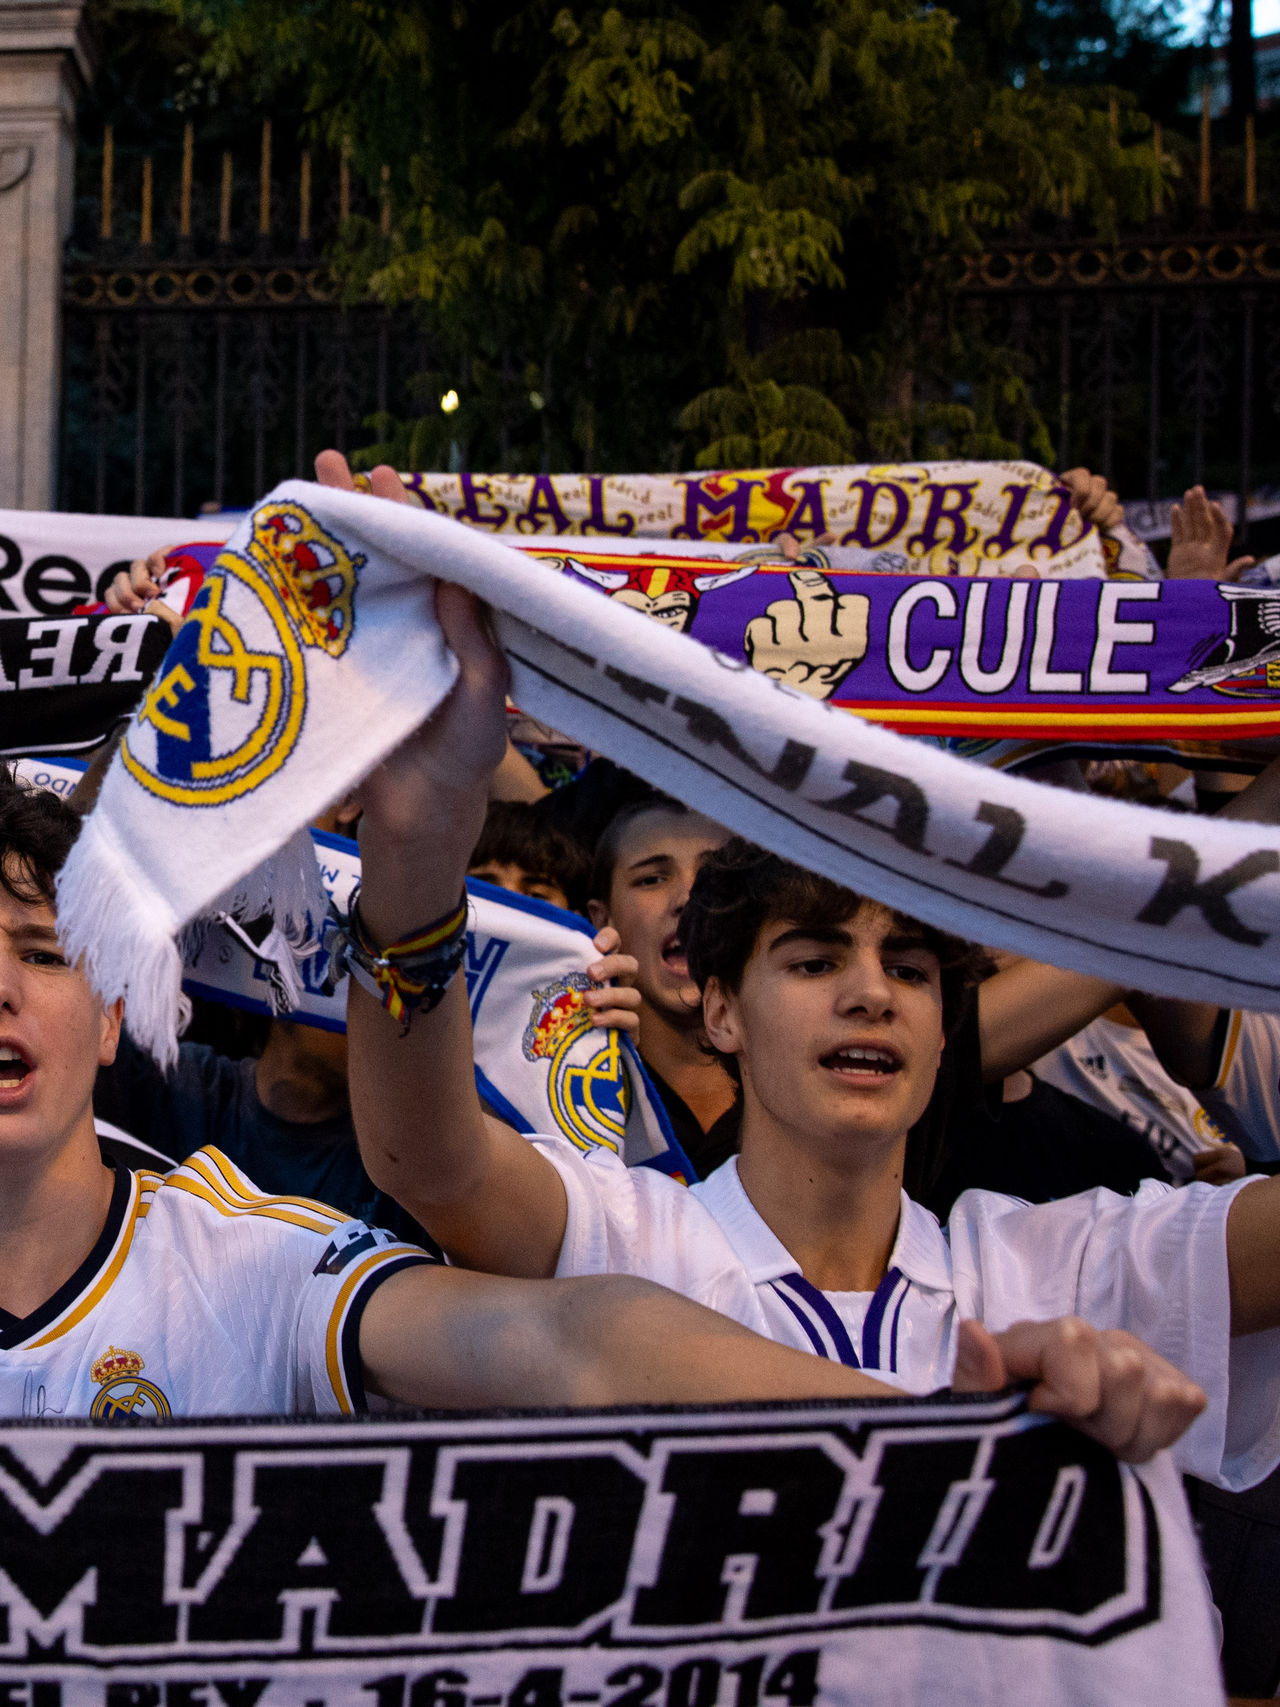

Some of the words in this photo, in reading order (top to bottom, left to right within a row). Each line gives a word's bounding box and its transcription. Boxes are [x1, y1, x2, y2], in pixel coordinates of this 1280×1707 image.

[671, 477, 1098, 561] MADRID
[887, 580, 1162, 695] CULE
[362, 1649, 823, 1707] 16-4-2014
